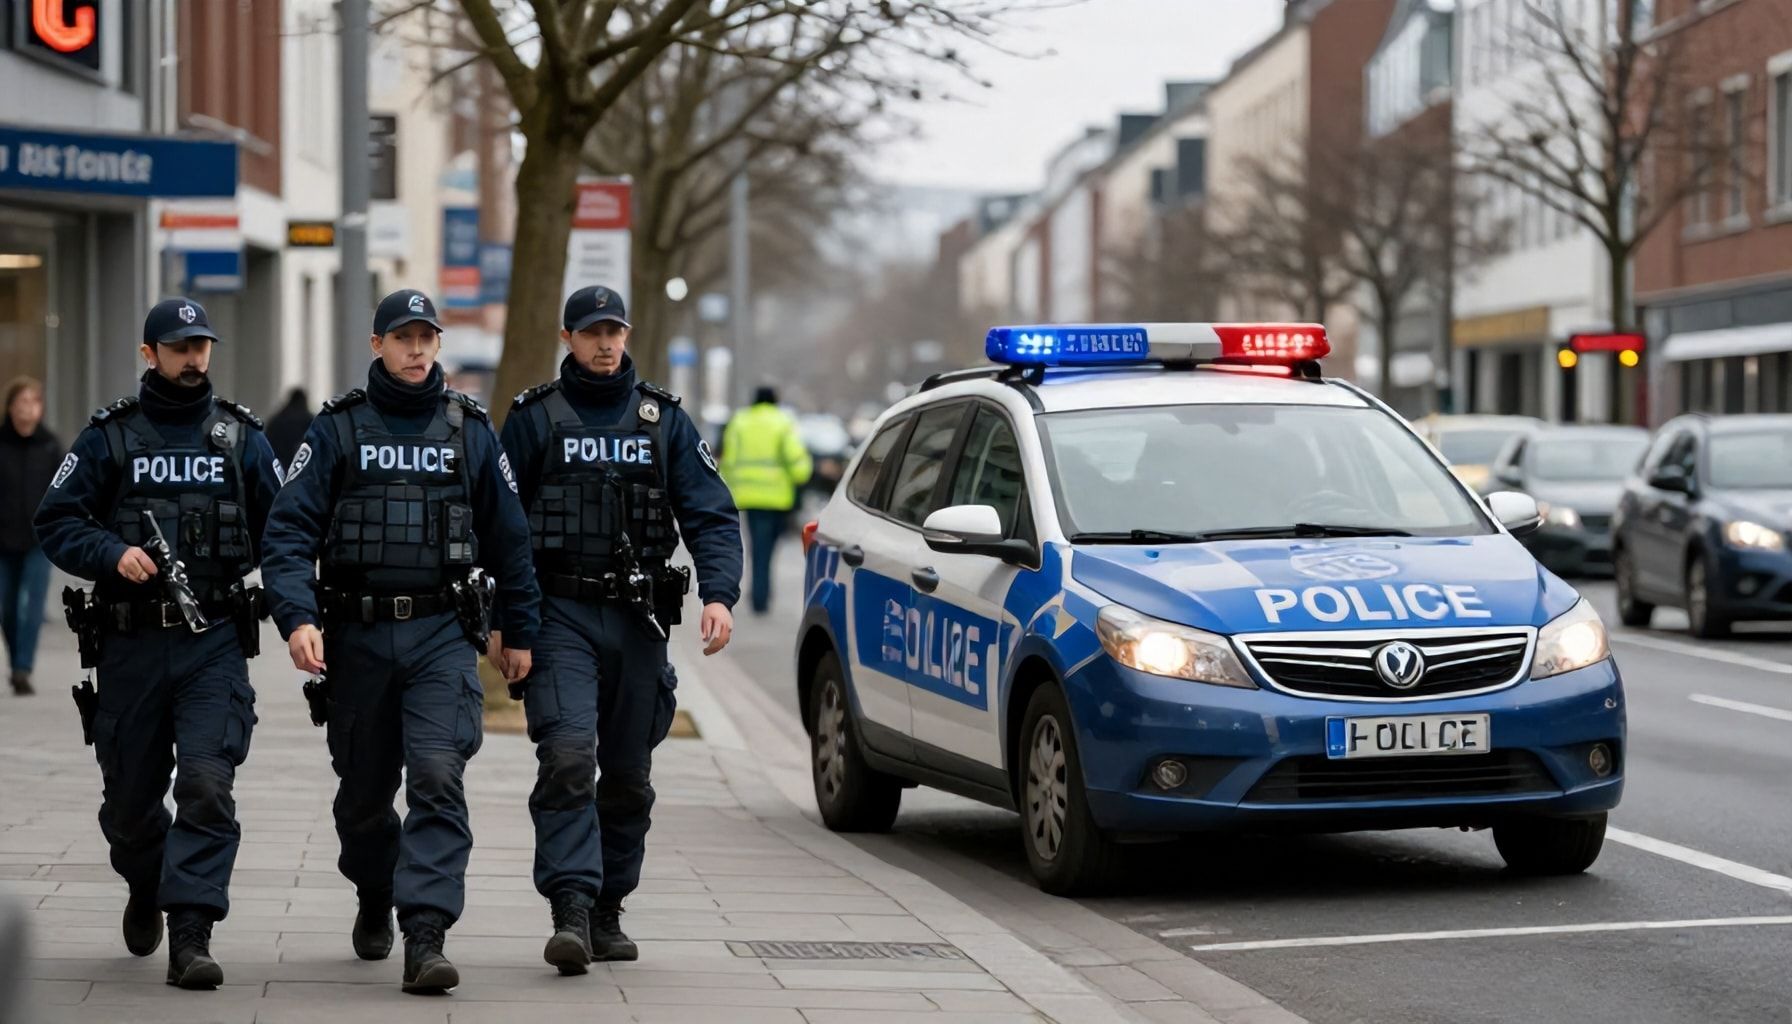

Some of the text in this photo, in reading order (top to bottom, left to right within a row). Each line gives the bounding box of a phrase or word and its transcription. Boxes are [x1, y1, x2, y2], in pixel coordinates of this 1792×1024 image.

[360, 444, 455, 473] POLICE
[563, 437, 653, 464] POLICE
[133, 456, 225, 483] POLICE
[1254, 583, 1492, 624] POLICE
